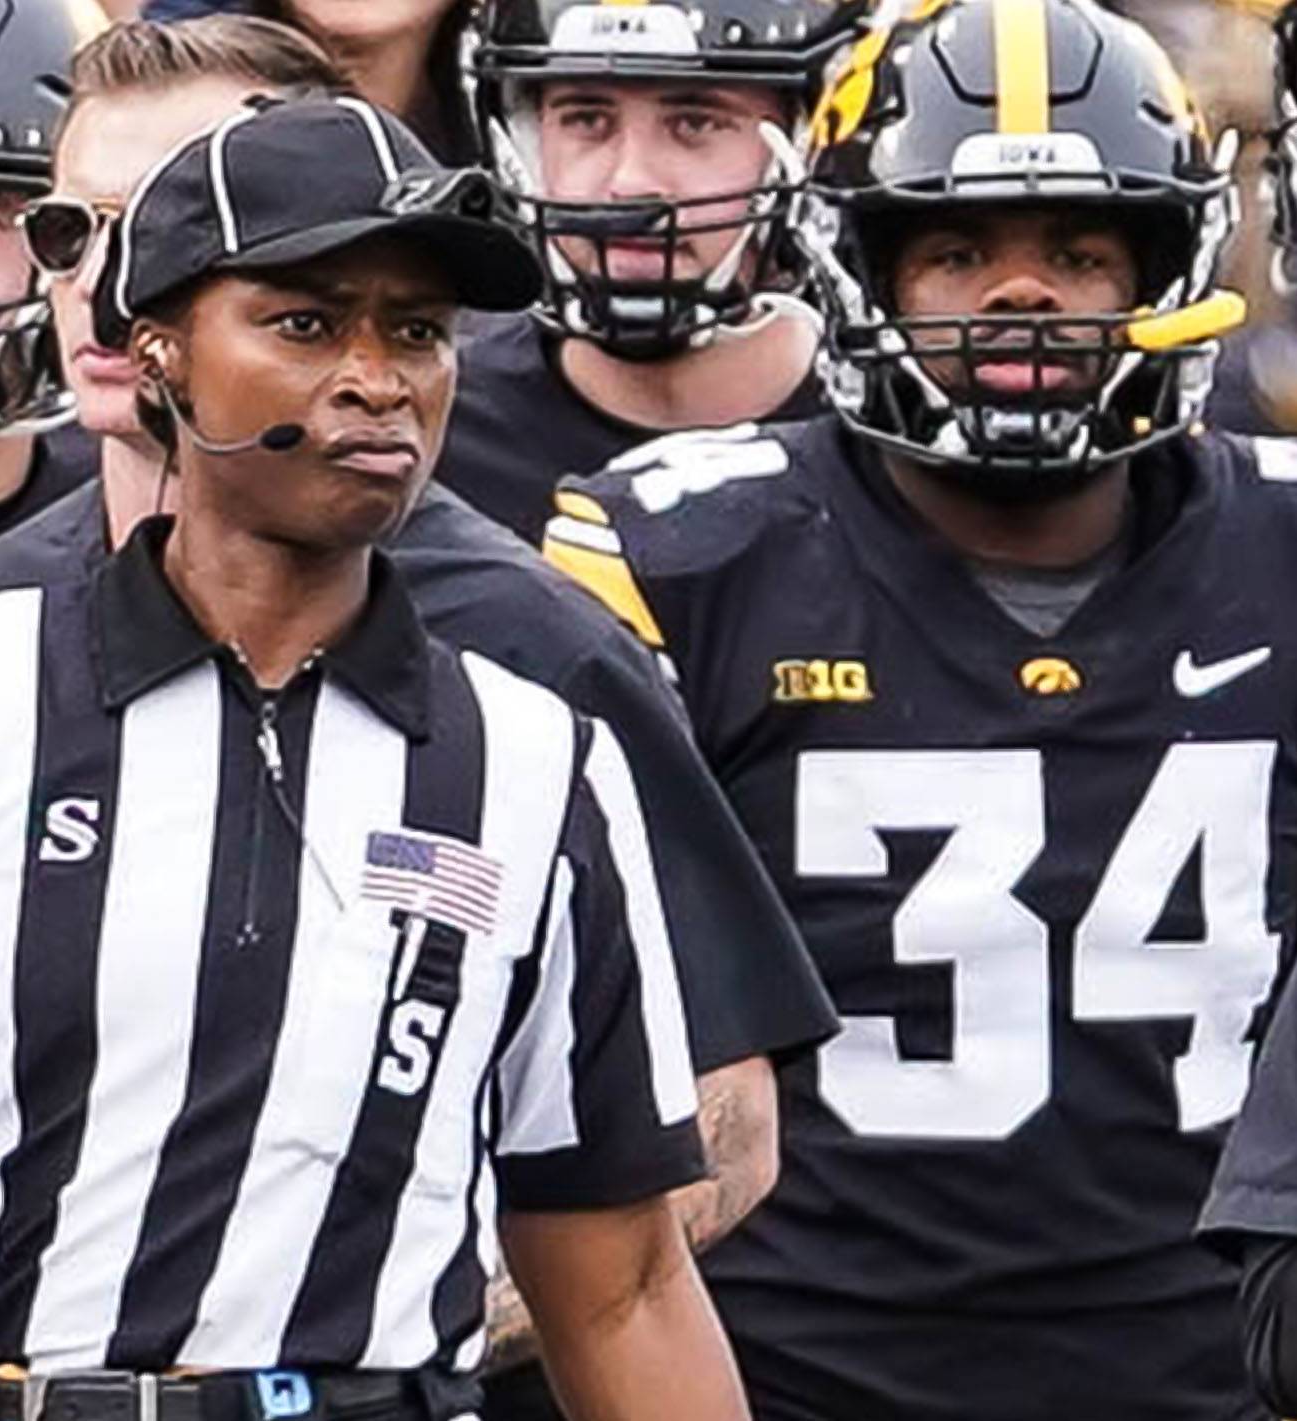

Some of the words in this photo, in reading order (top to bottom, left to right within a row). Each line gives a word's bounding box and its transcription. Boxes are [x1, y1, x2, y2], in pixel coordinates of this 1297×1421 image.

[38, 796, 100, 862] S
[795, 739, 1283, 1139] 34
[377, 998, 446, 1096] S
